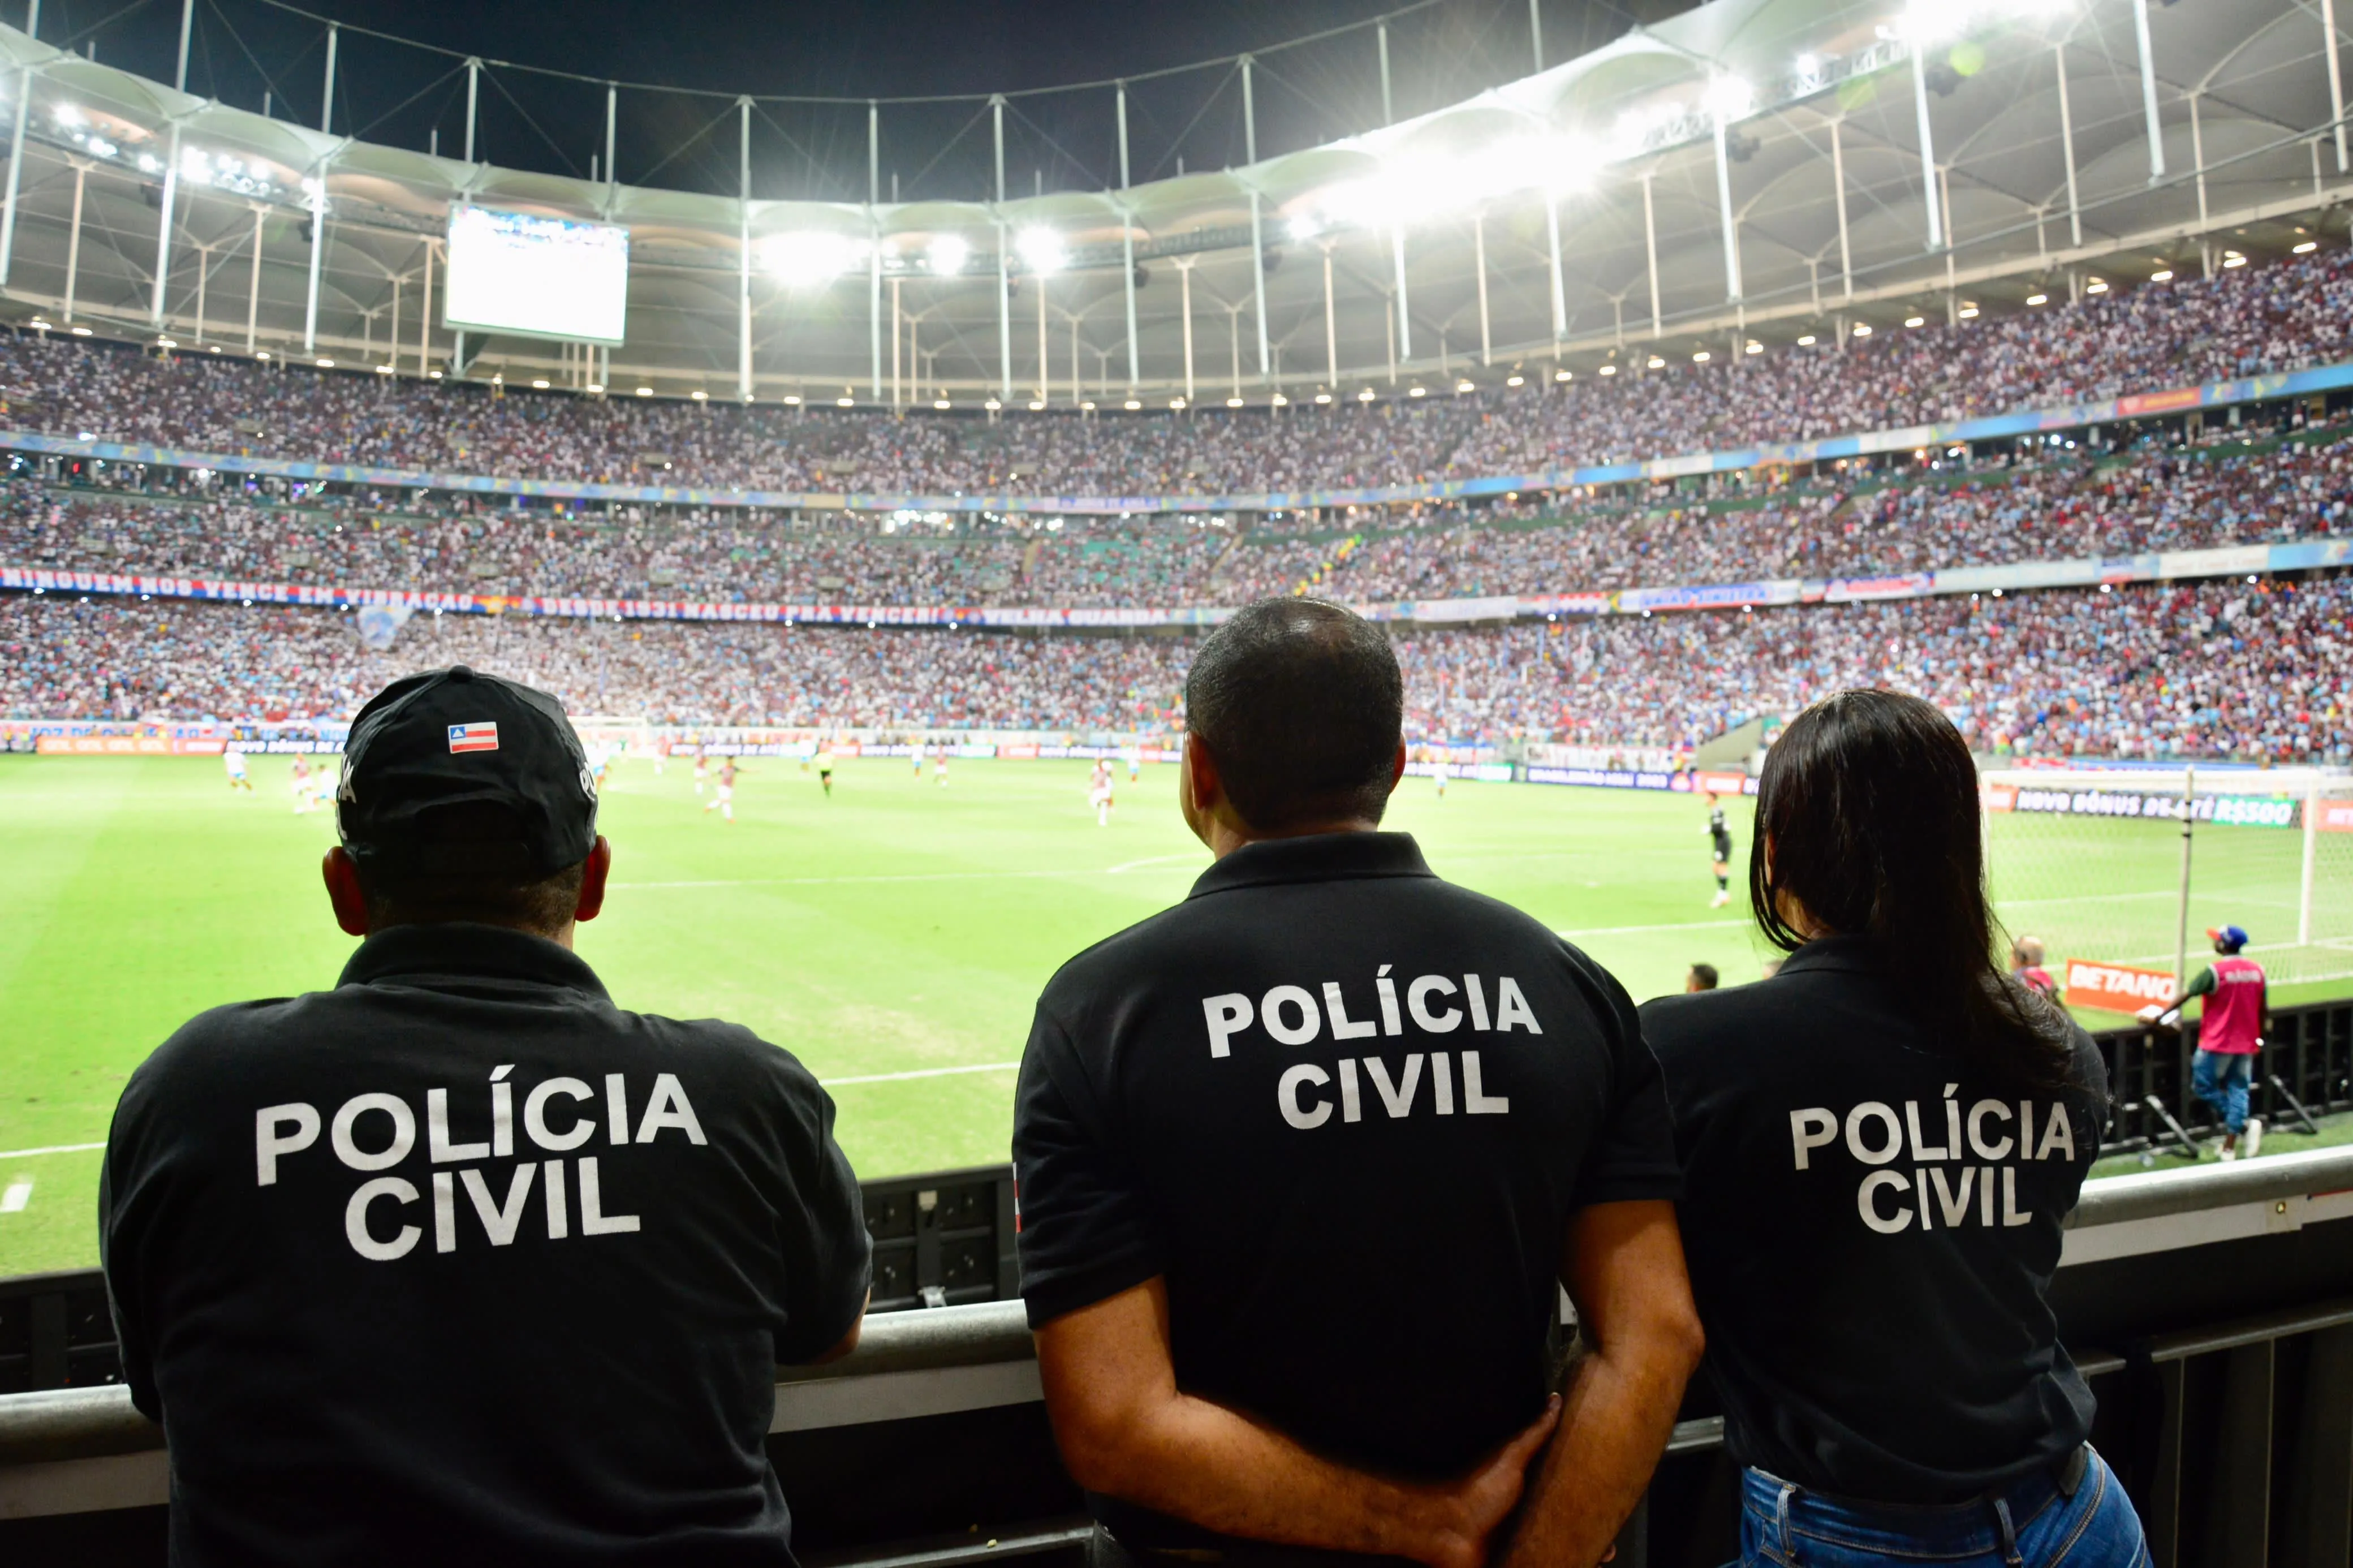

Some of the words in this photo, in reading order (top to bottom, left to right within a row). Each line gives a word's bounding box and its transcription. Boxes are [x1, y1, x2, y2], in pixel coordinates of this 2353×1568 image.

[139, 576, 192, 596] NOS
[201, 580, 287, 602] VENCE
[299, 586, 335, 604] EM
[2017, 790, 2070, 811] NOVO
[2072, 789, 2140, 815] BÔNUS
[2214, 799, 2292, 825] R$500
[1203, 964, 1543, 1058] POLÍCIA
[2070, 964, 2176, 1000] BETANO
[256, 1064, 708, 1186] POLÍCIA
[1278, 1050, 1509, 1129] CIVIL
[1790, 1083, 2075, 1170] POLÍCIA
[345, 1156, 640, 1261] CIVIL
[1858, 1166, 2032, 1234] CIVIL
